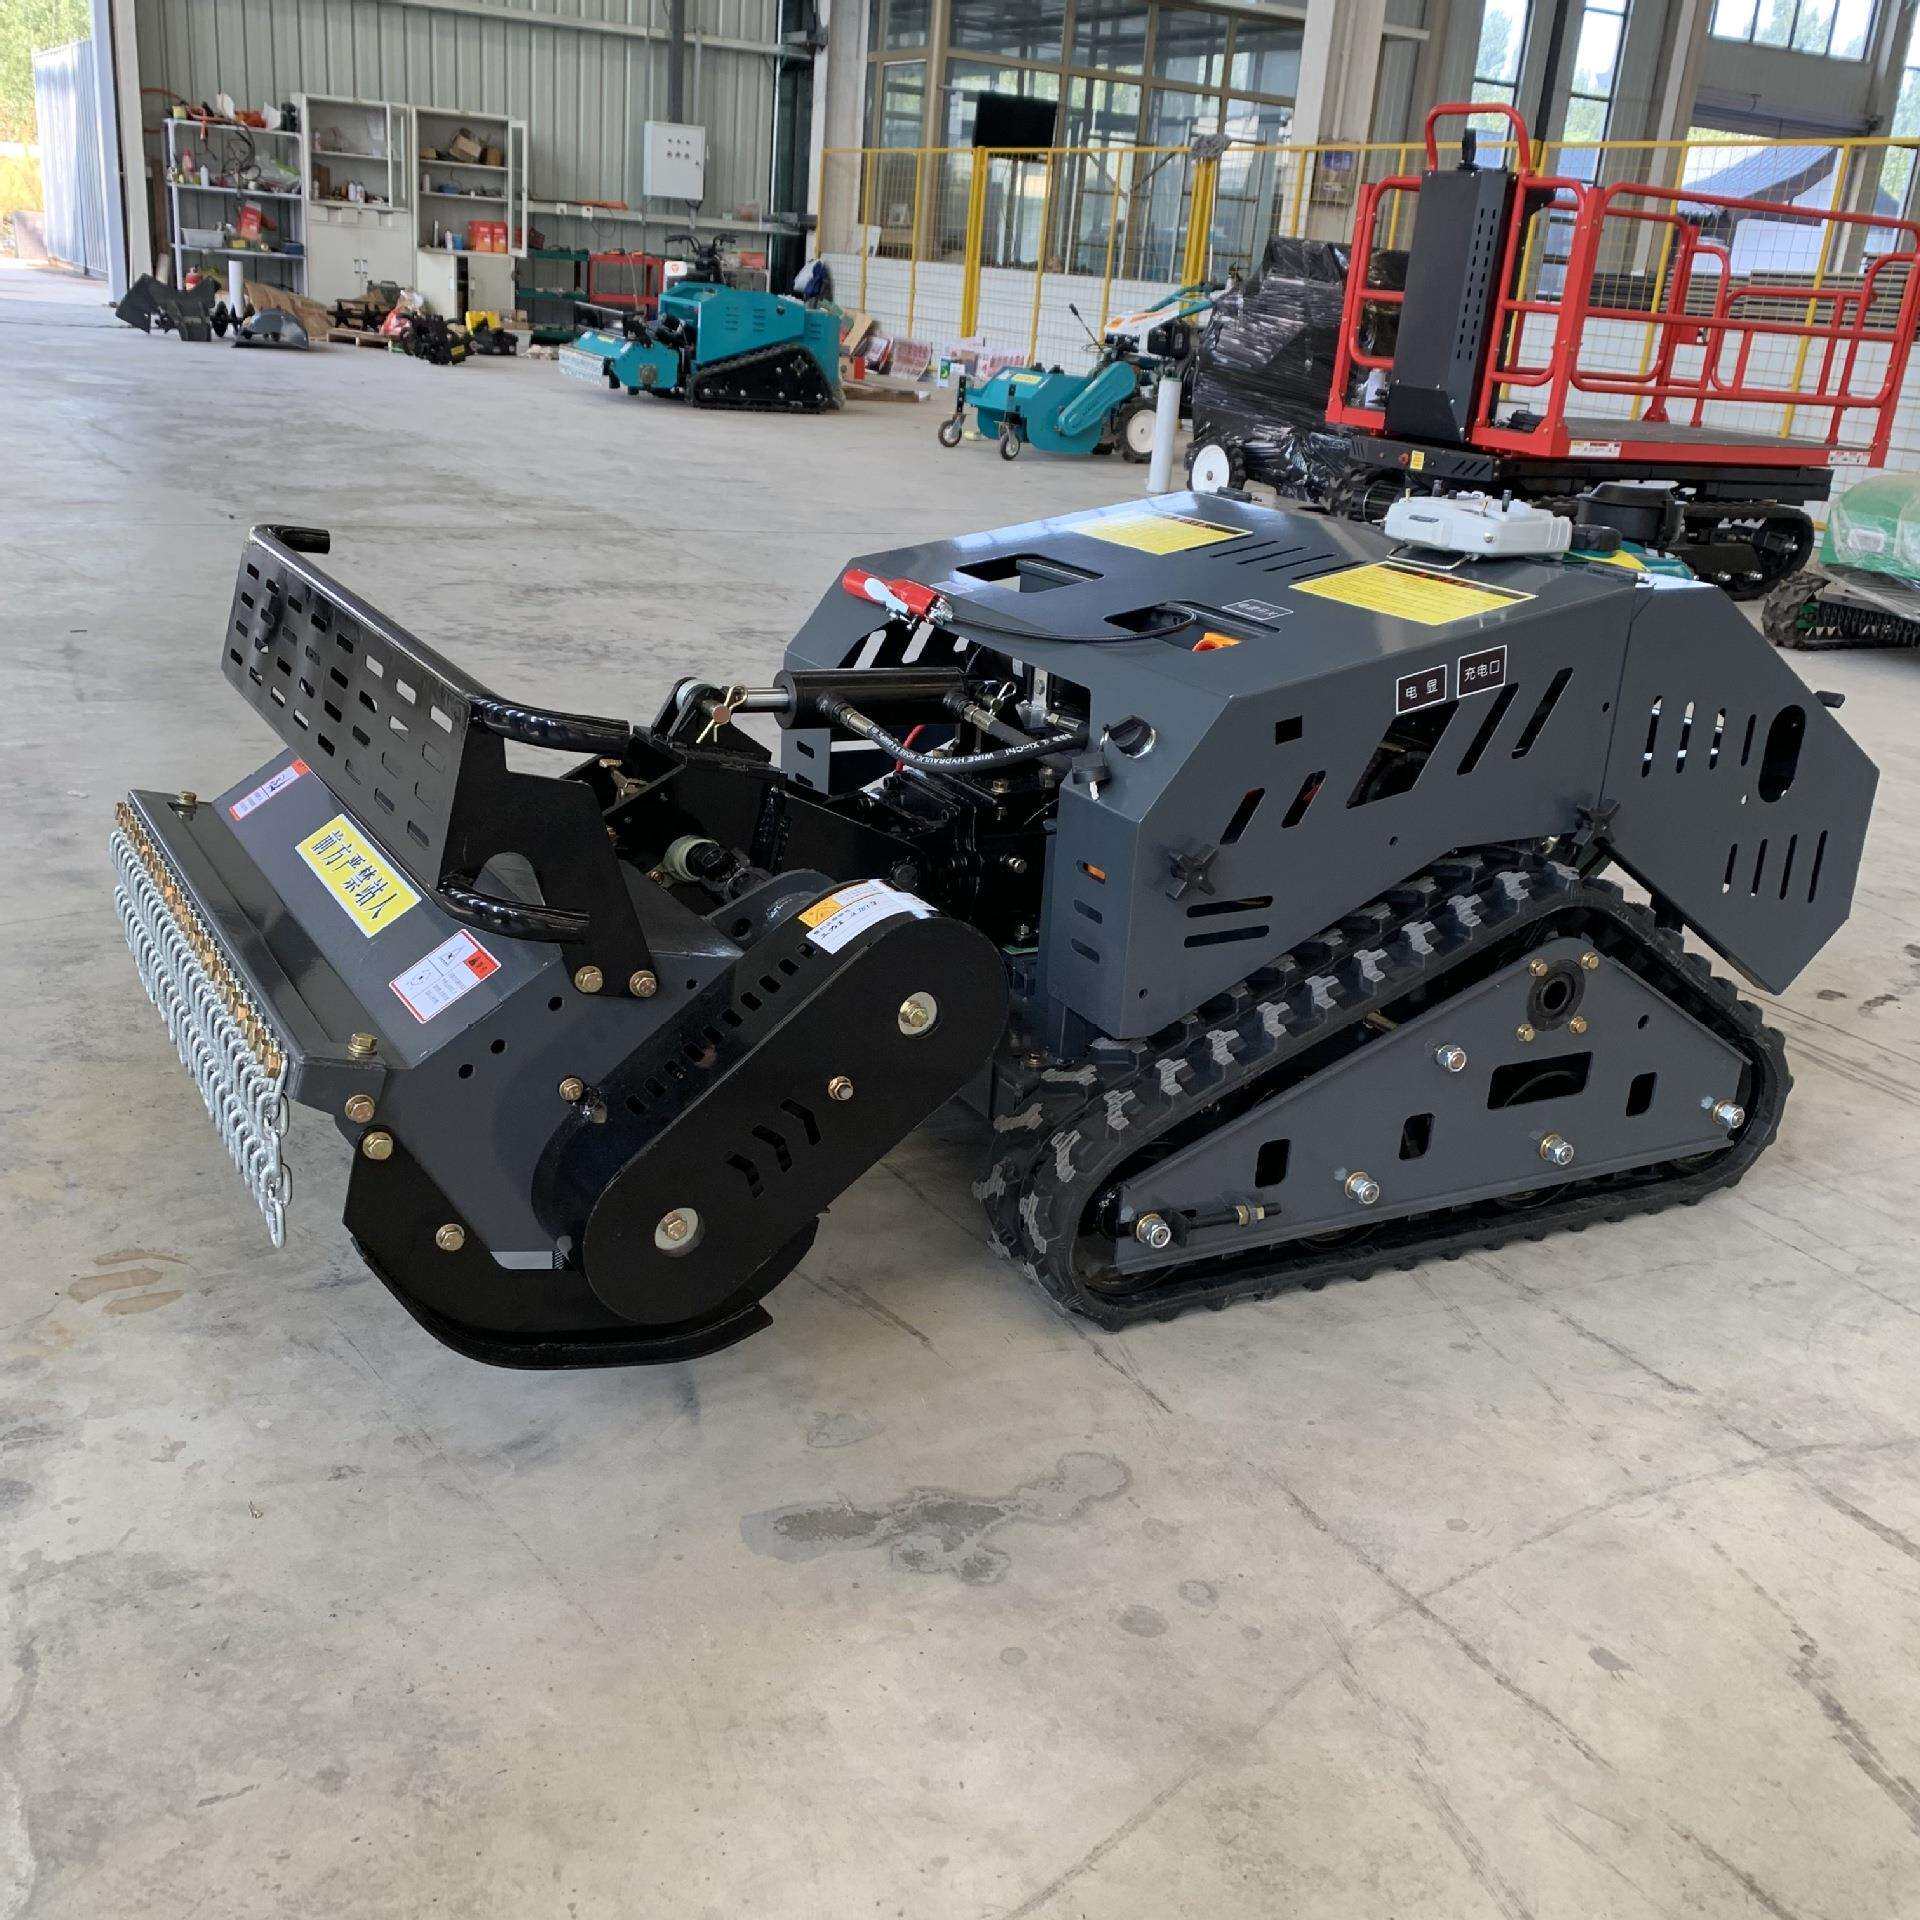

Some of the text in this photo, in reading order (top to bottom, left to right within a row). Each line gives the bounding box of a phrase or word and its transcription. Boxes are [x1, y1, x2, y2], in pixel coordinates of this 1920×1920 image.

[1464, 660, 1500, 681] 充电口
[967, 752, 994, 763] WIRE
[311, 830, 398, 920] 前方严禁站人
